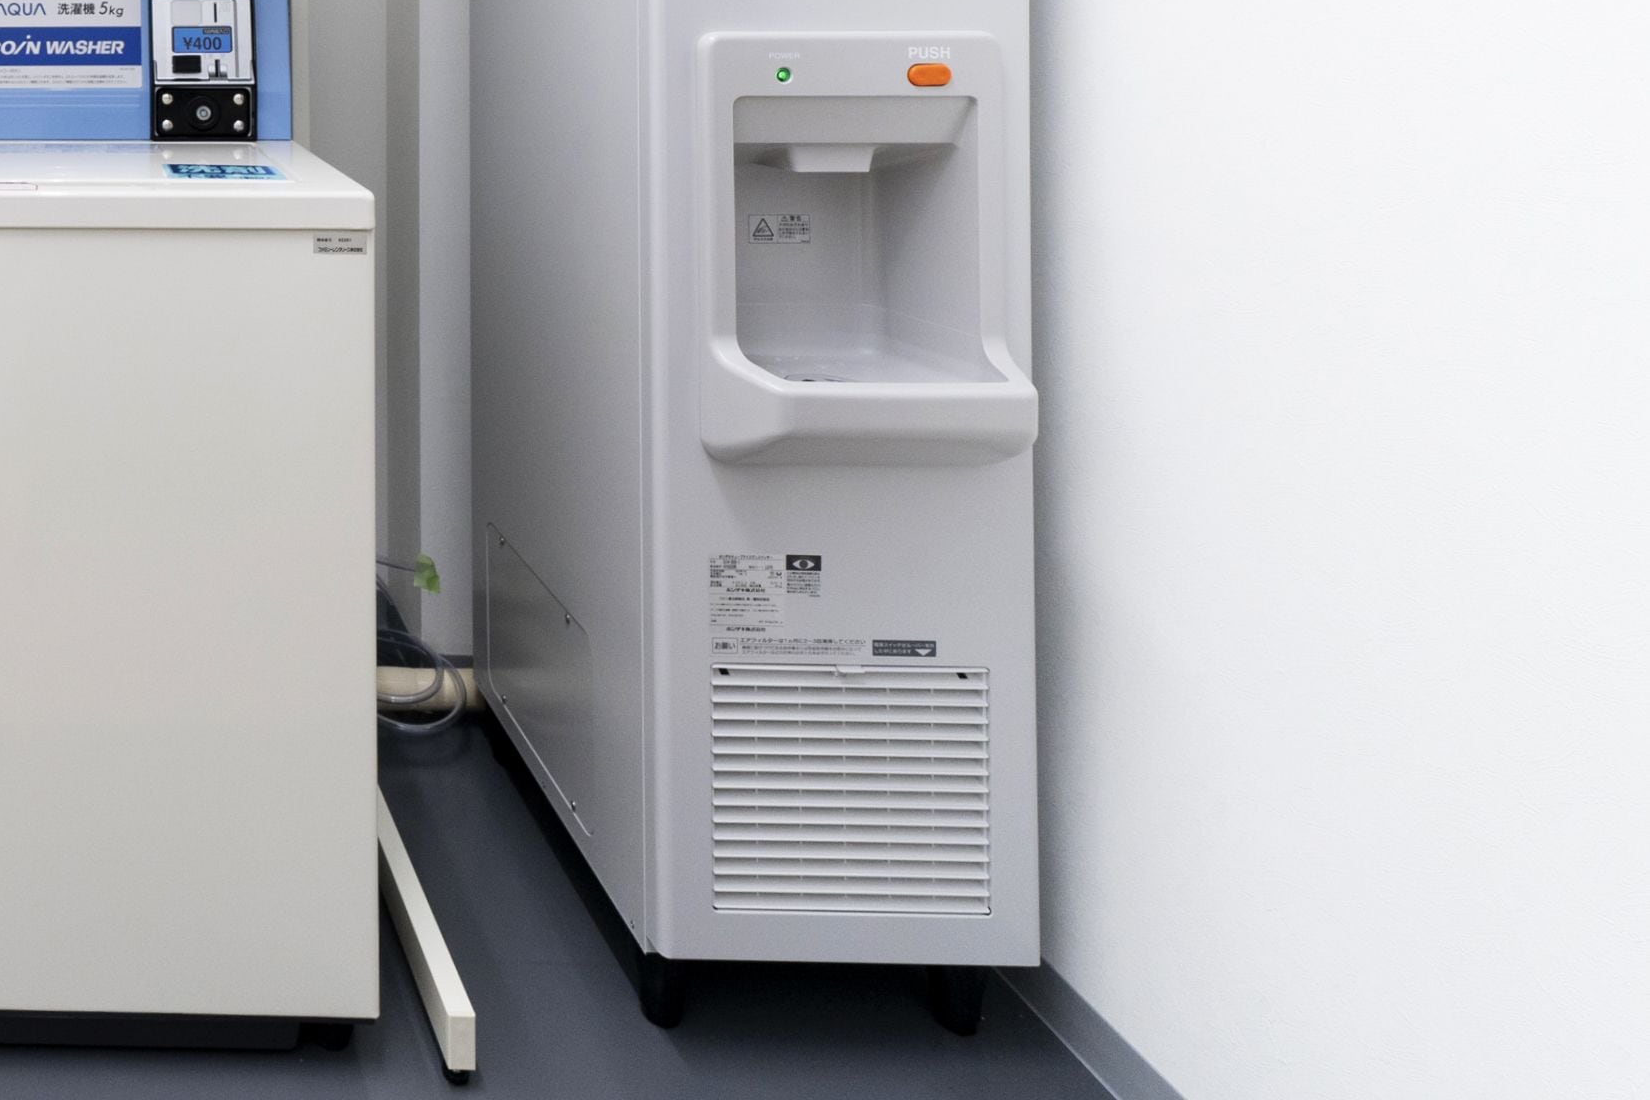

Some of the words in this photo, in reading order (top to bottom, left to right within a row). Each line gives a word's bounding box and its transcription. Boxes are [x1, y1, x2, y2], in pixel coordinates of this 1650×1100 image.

[57, 2, 95, 16] 洗濯機
[98, 1, 124, 17] 5kg
[46, 40, 125, 54] WASHER
[183, 36, 222, 50] ¥400
[769, 52, 800, 60] POWER
[908, 46, 951, 59] PUSH
